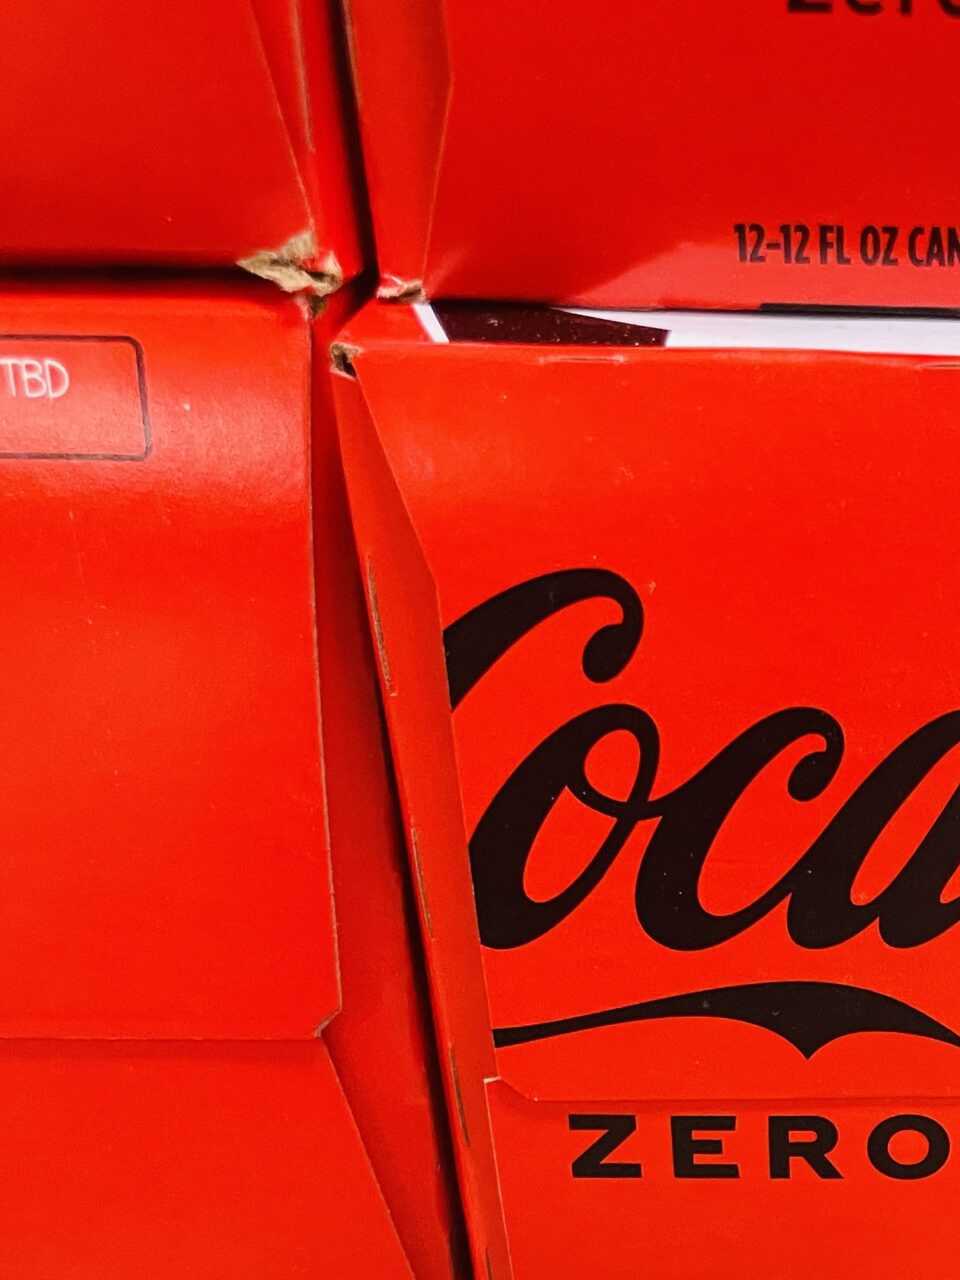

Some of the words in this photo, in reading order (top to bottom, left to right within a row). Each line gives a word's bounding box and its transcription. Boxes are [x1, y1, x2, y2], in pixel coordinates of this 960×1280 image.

[733, 223, 811, 265] 12-12
[819, 225, 852, 265] FL
[860, 225, 899, 267] OZ
[567, 1111, 953, 1182] ZERO
